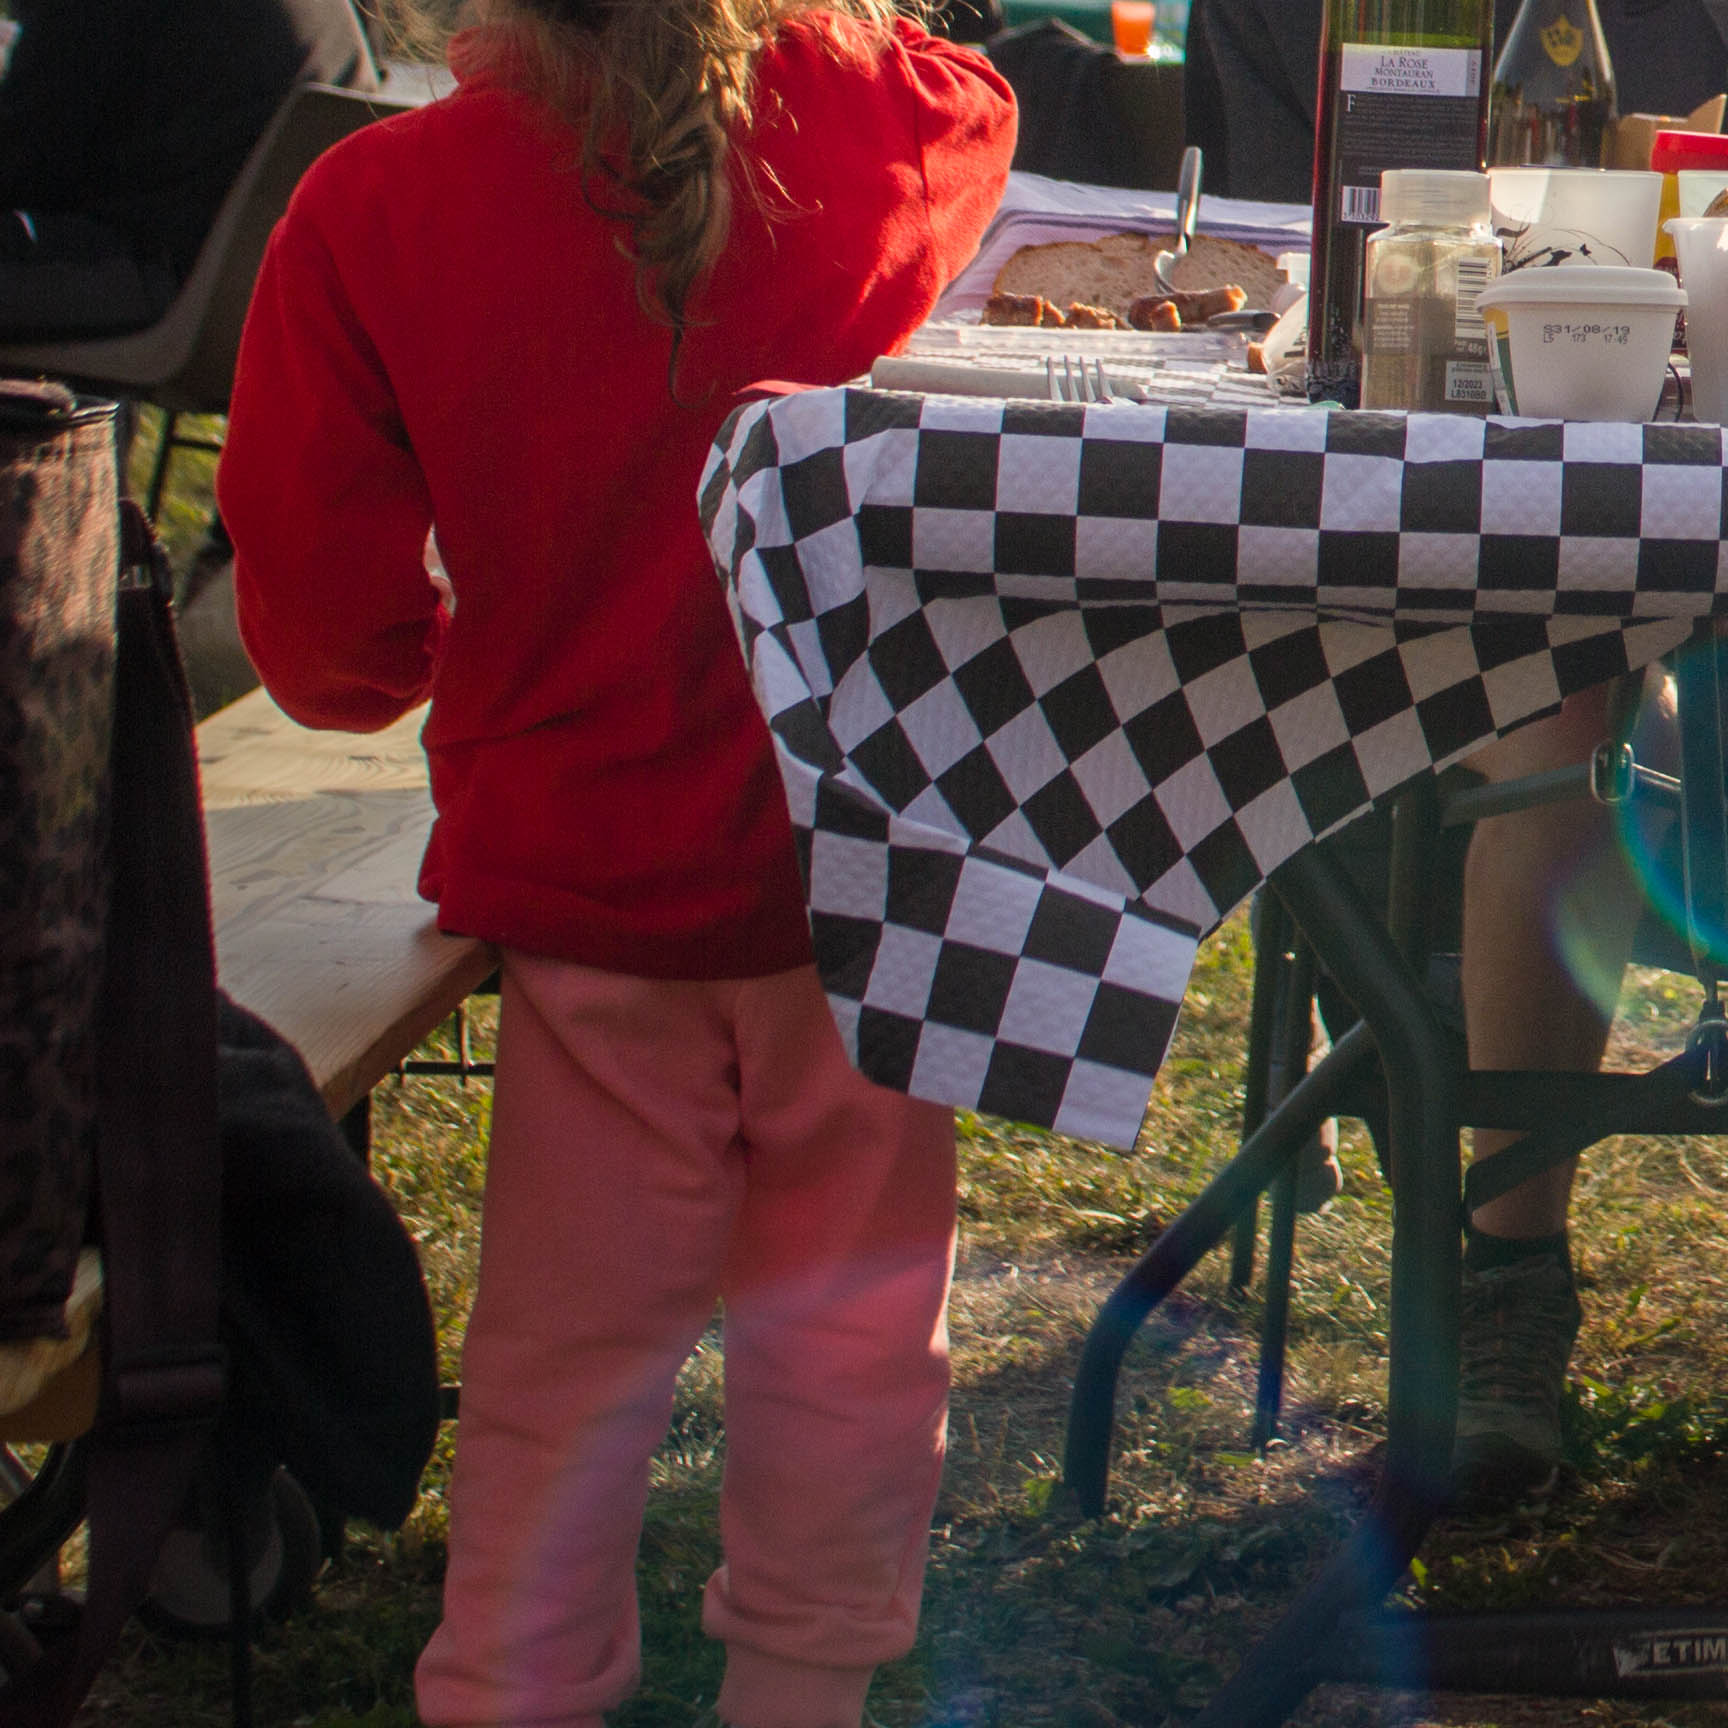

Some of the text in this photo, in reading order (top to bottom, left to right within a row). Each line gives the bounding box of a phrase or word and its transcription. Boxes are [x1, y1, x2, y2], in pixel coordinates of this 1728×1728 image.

[1381, 55, 1429, 70] LA ROSE
[1371, 78, 1436, 89] BORDEAUX
